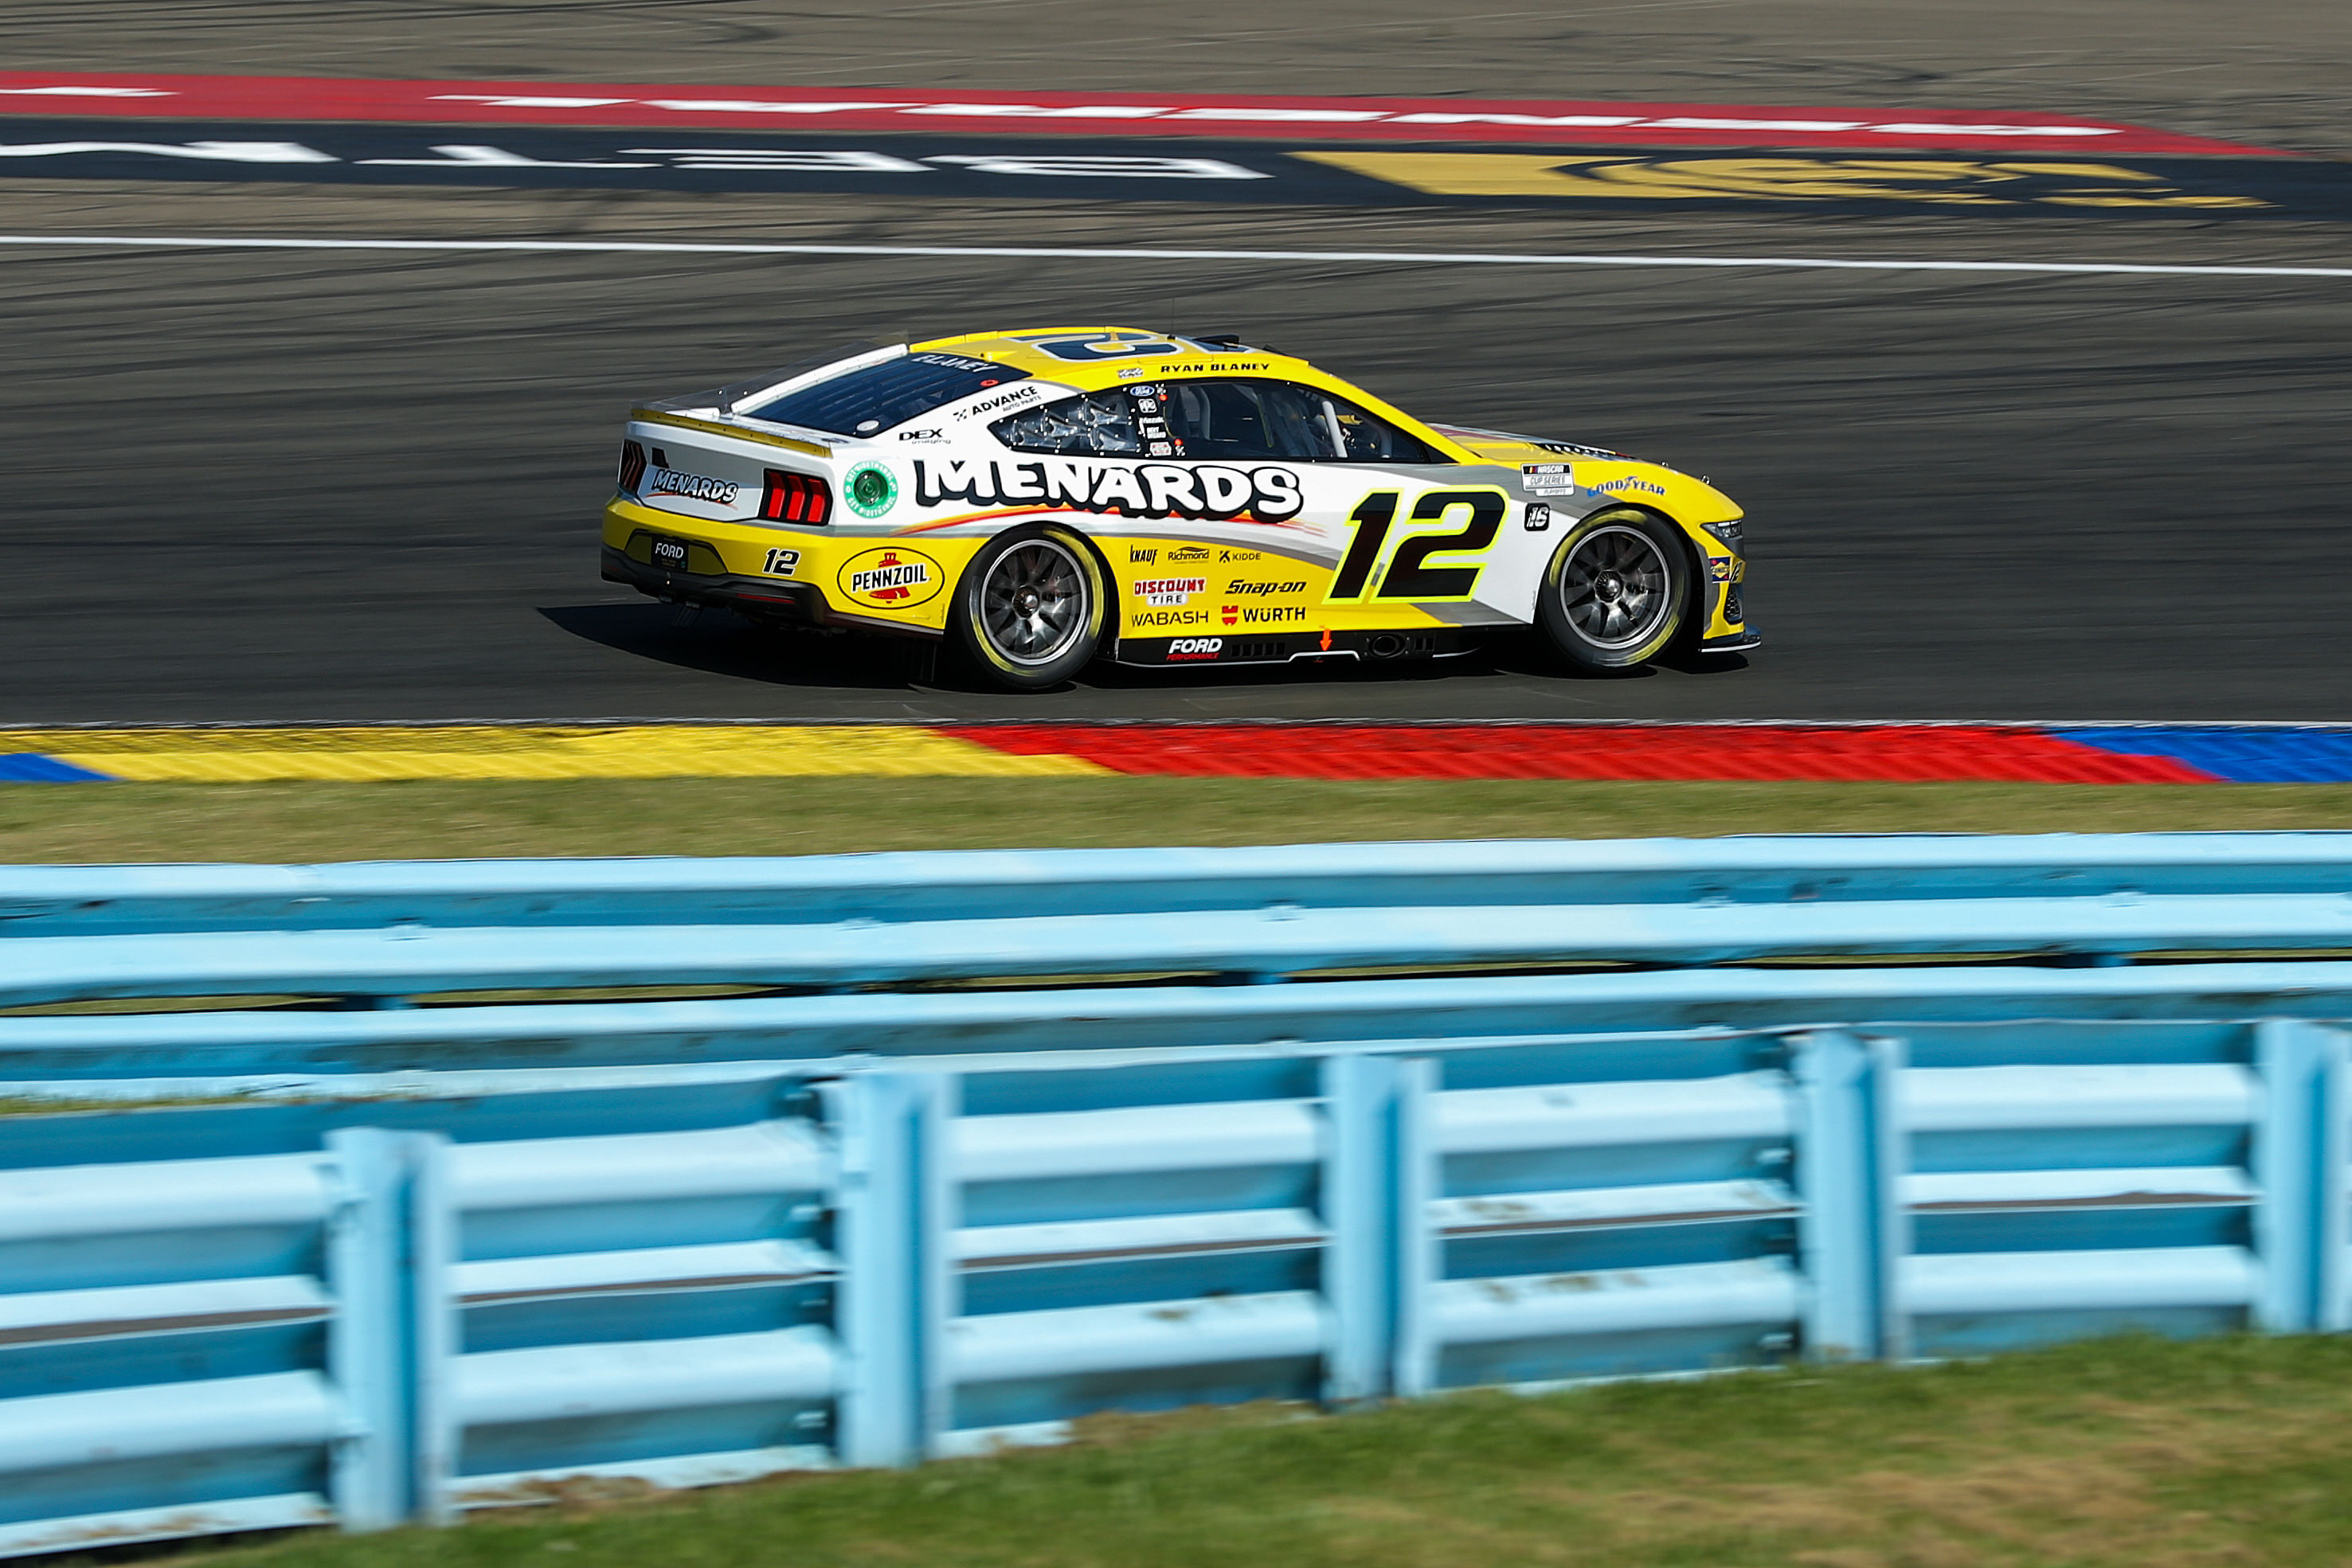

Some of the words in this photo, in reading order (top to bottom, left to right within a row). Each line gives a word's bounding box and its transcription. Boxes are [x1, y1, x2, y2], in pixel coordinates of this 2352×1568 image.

[972, 386, 1038, 416] ADVANCE
[1003, 401, 1021, 413] AUTO
[1020, 395, 1042, 405] PARTS
[898, 428, 943, 441] DEX
[1537, 465, 1564, 474] NASCAR
[651, 469, 739, 504] MENARDS
[1530, 475, 1543, 485] CUP
[1544, 475, 1566, 485] SERIES
[1586, 476, 1665, 498] GOODYEAR
[913, 459, 1304, 523] MENARDS
[655, 542, 684, 559] FORD
[1321, 484, 1510, 604] 12
[762, 547, 801, 577] 12
[1168, 549, 1210, 561] Richmond
[1232, 552, 1262, 561] KIDDE
[851, 564, 928, 592] PENNZOIL
[1134, 578, 1205, 595] DISCOUNT
[1225, 580, 1307, 596] Snap-on
[1151, 595, 1183, 604] TIRE
[1131, 611, 1209, 628] WABASH
[1168, 638, 1223, 654] FORD
[1166, 652, 1220, 661] PERFORMANCE
